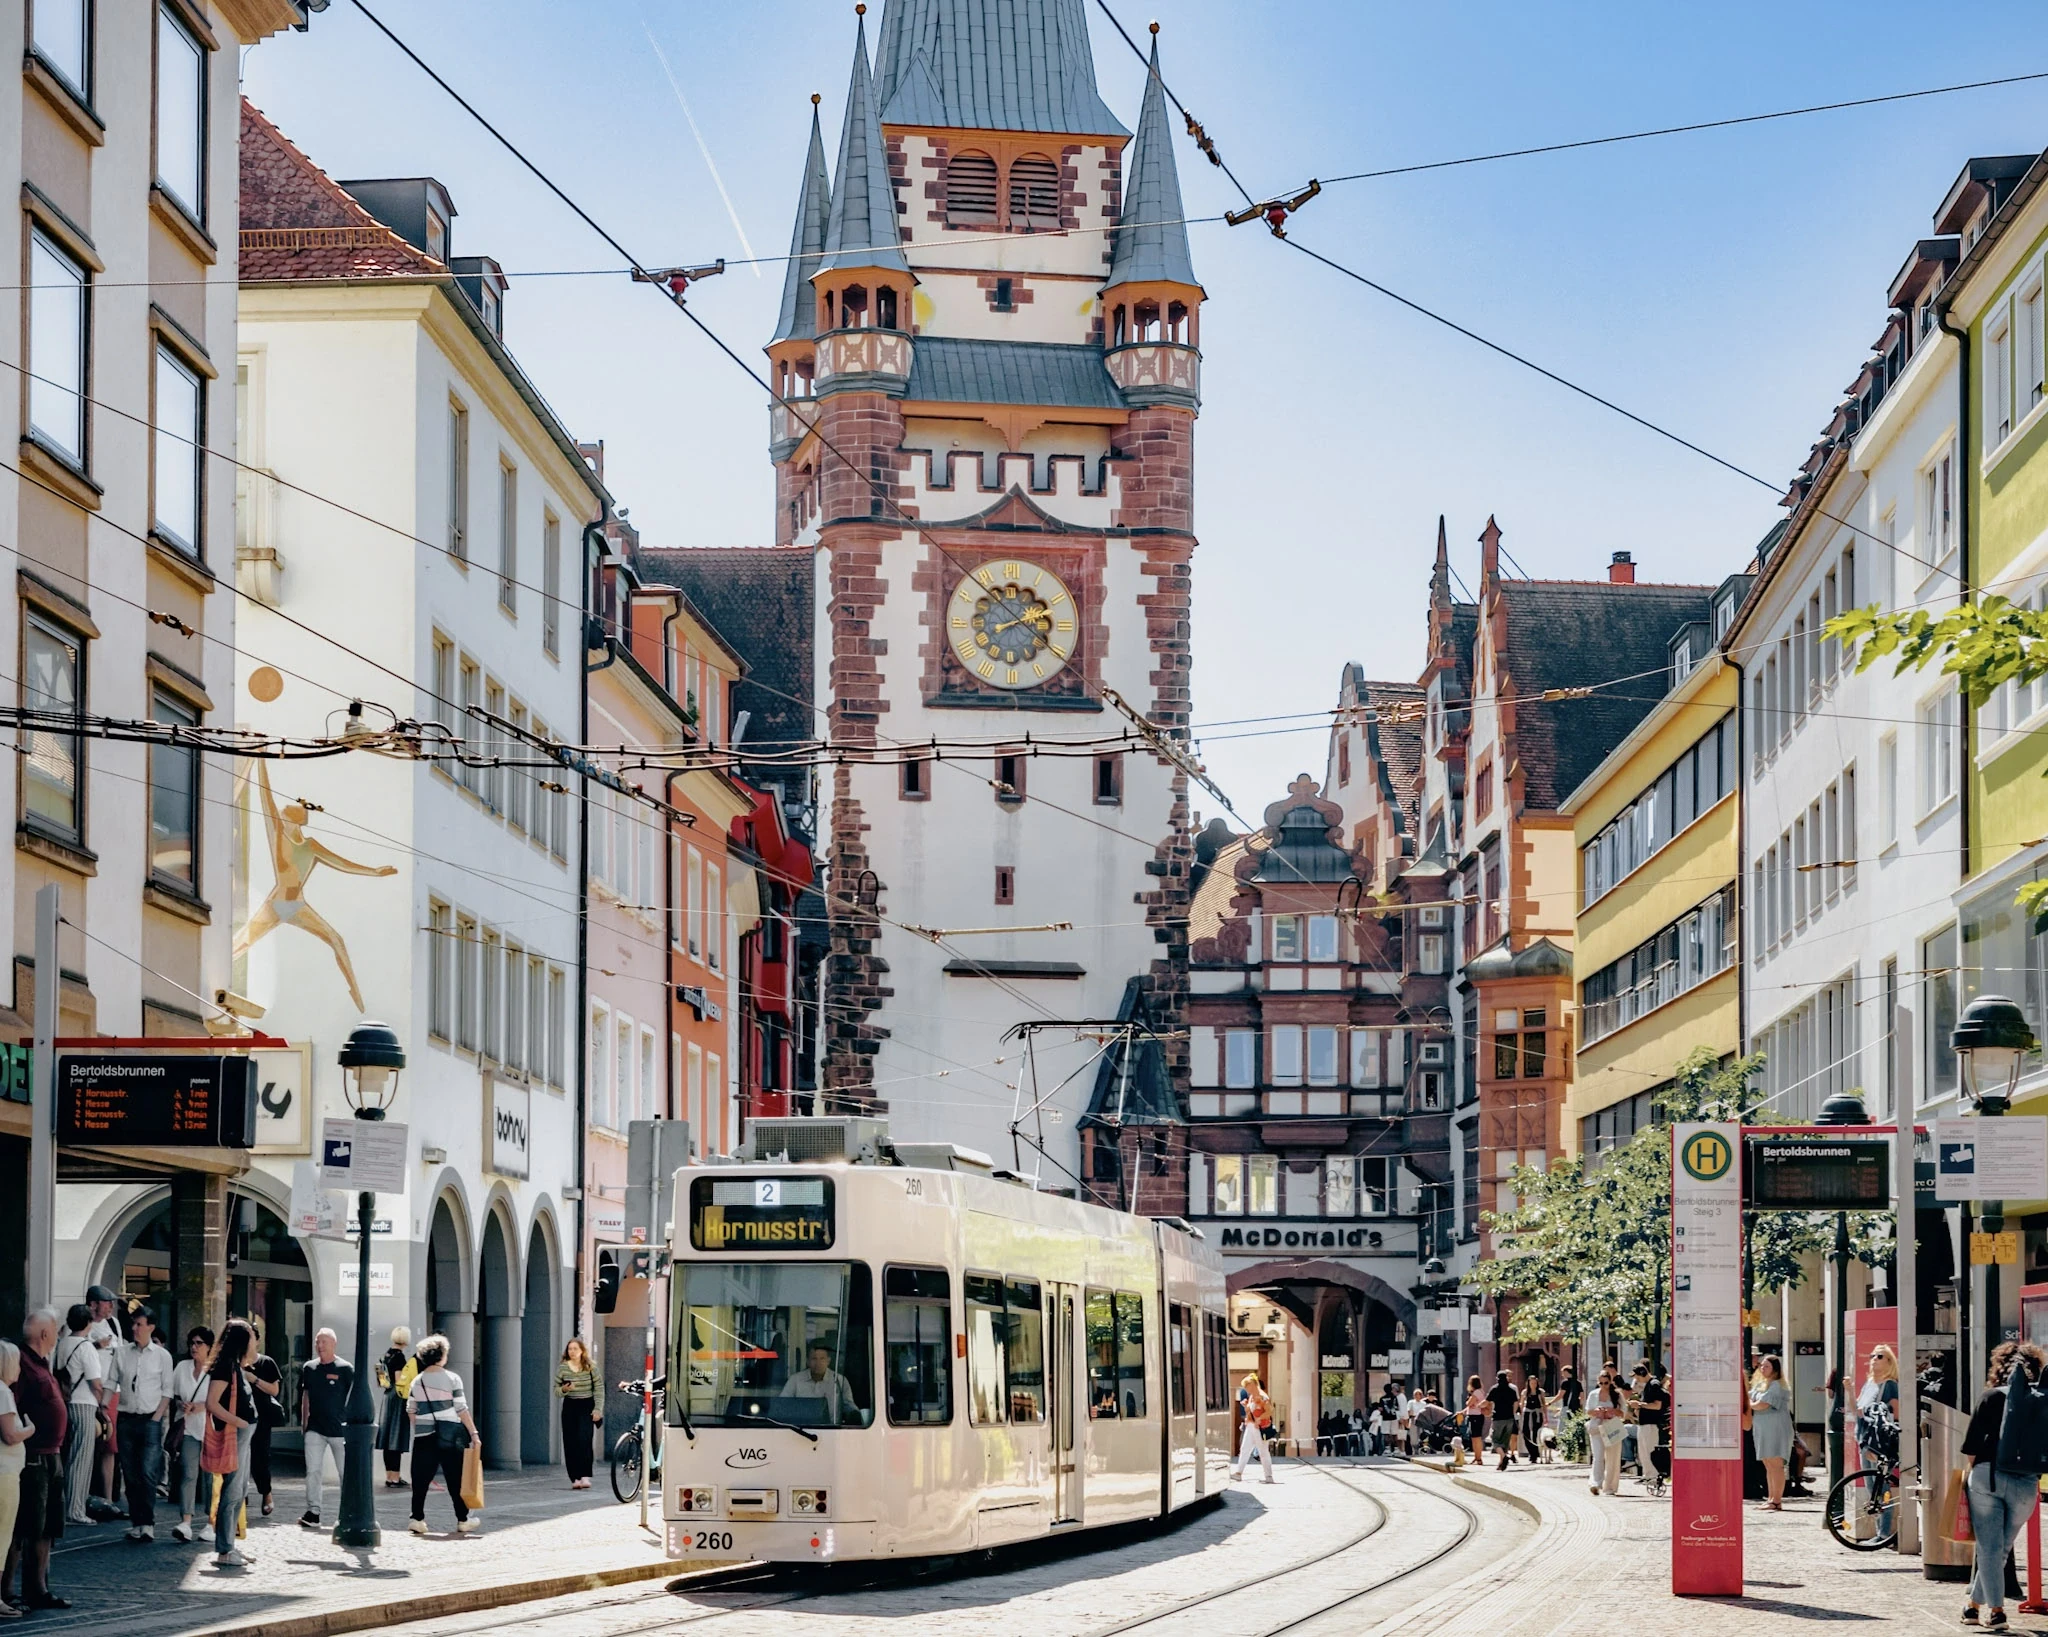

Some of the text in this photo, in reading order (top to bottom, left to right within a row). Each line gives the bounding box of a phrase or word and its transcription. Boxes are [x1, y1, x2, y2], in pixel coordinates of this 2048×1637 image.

[70, 1064, 165, 1076] Bertoldsbrunnen
[1697, 1142, 1717, 1170] H
[1763, 1147, 1851, 1156] Bertoldsbrunnen
[762, 1184, 773, 1202] 2
[906, 1178, 922, 1196] 260
[1693, 1208, 1722, 1217] Steig 3
[1222, 1228, 1383, 1247] McDonald's
[2005, 1330, 2020, 1340] Sch
[738, 1448, 768, 1460] VAG
[1699, 1515, 1719, 1523] VAG
[696, 1532, 733, 1550] 260
